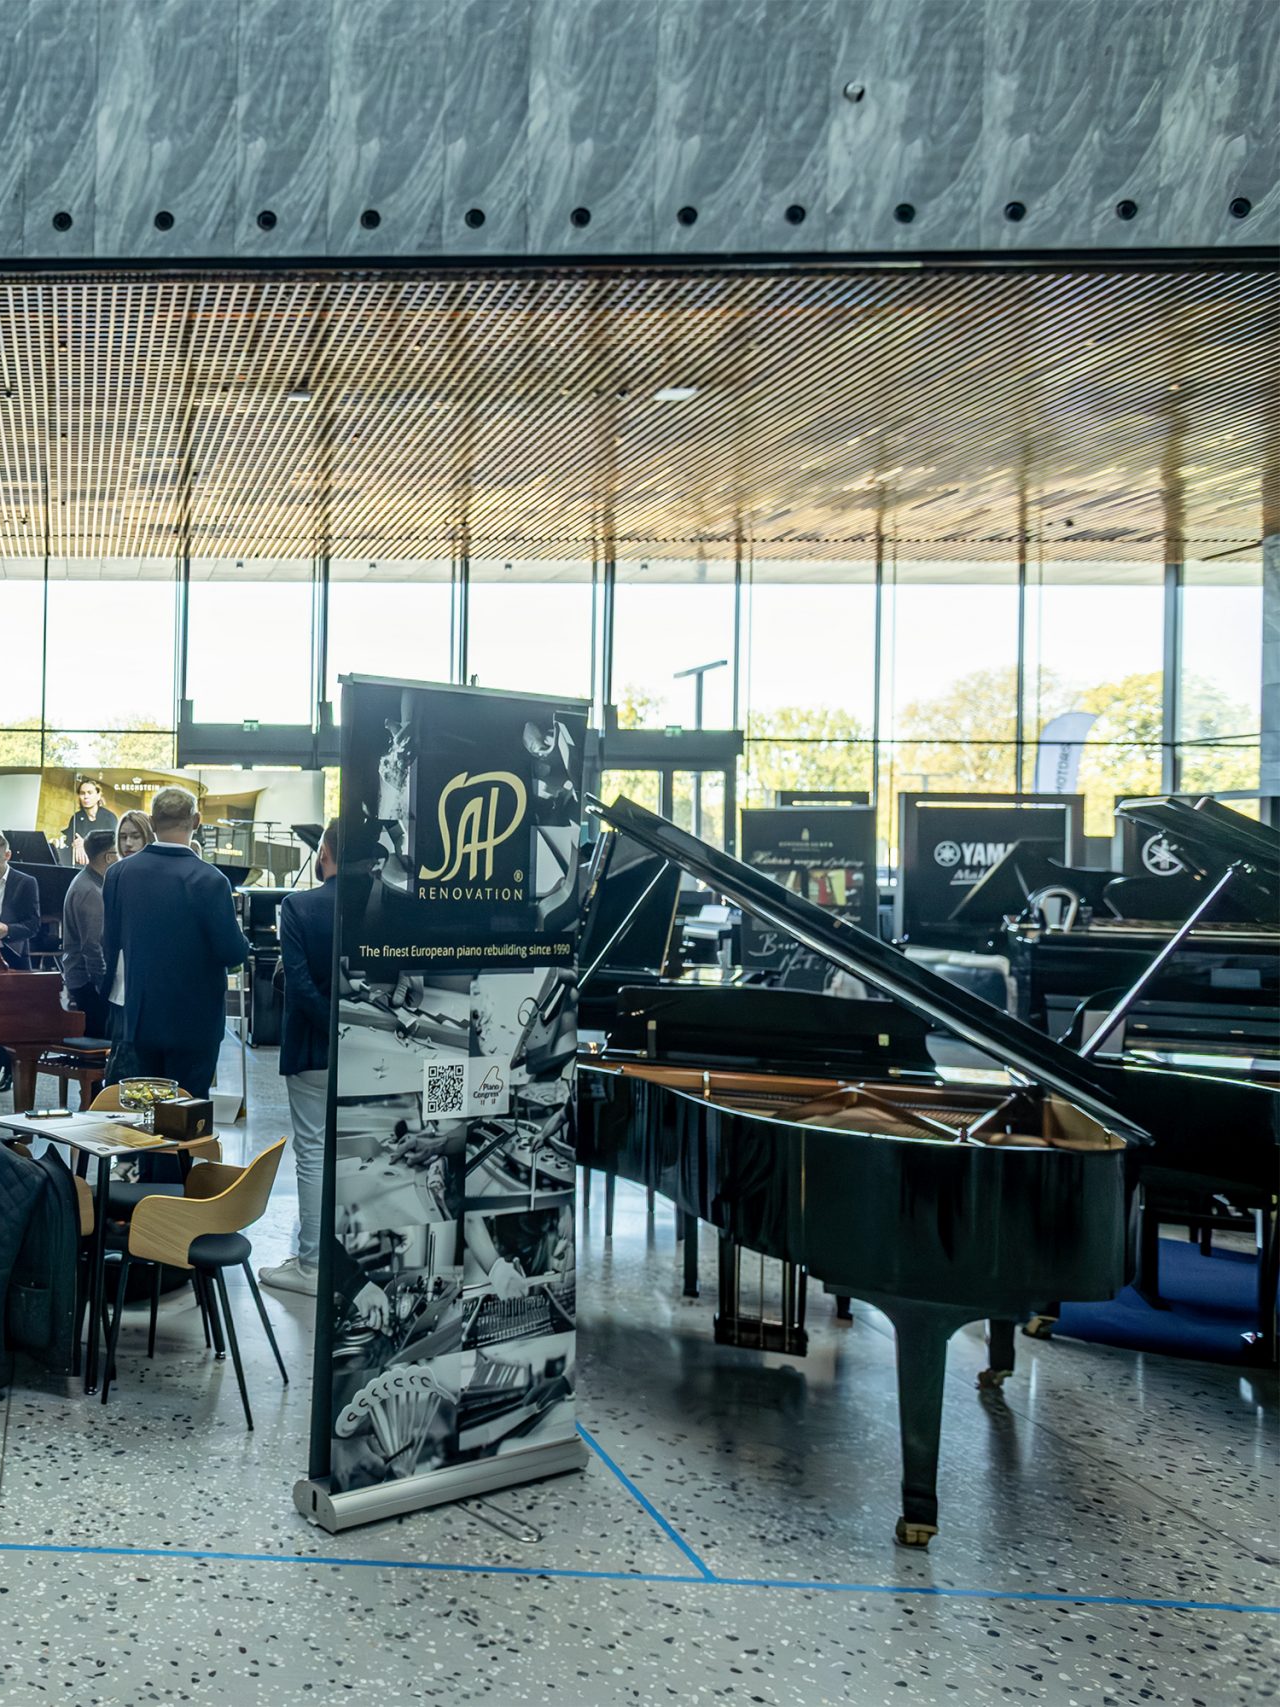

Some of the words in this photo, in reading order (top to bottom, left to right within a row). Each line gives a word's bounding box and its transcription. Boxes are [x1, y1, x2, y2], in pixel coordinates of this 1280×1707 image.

[419, 887, 524, 900] RENOVATION
[359, 945, 380, 957] The
[382, 945, 410, 957] finest
[411, 945, 455, 959] European
[456, 945, 481, 959] piano
[483, 944, 528, 959] rebuilding
[529, 944, 552, 955] since
[553, 943, 571, 955] 1990
[483, 1083, 500, 1091] Piano
